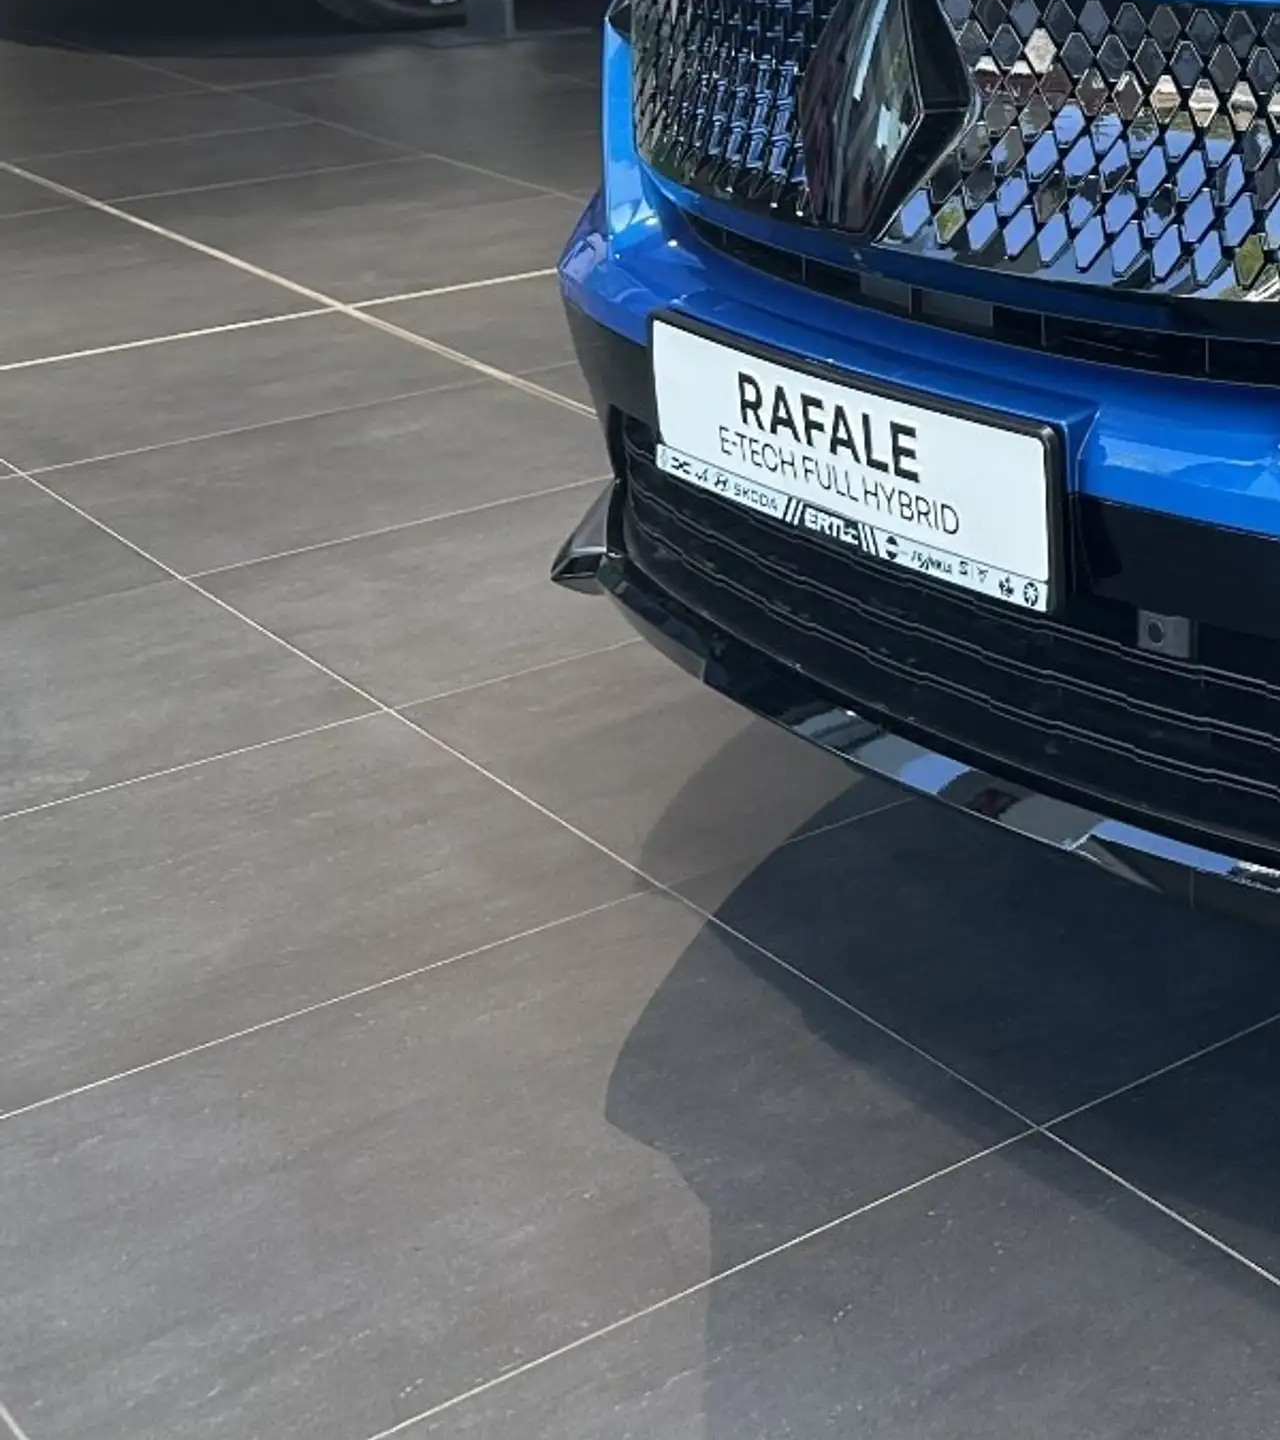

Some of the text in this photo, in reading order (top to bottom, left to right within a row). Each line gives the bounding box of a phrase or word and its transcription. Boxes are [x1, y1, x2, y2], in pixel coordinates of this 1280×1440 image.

[718, 424, 960, 535] E-TECH FULL HYBRID
[738, 371, 920, 483] RAFALE
